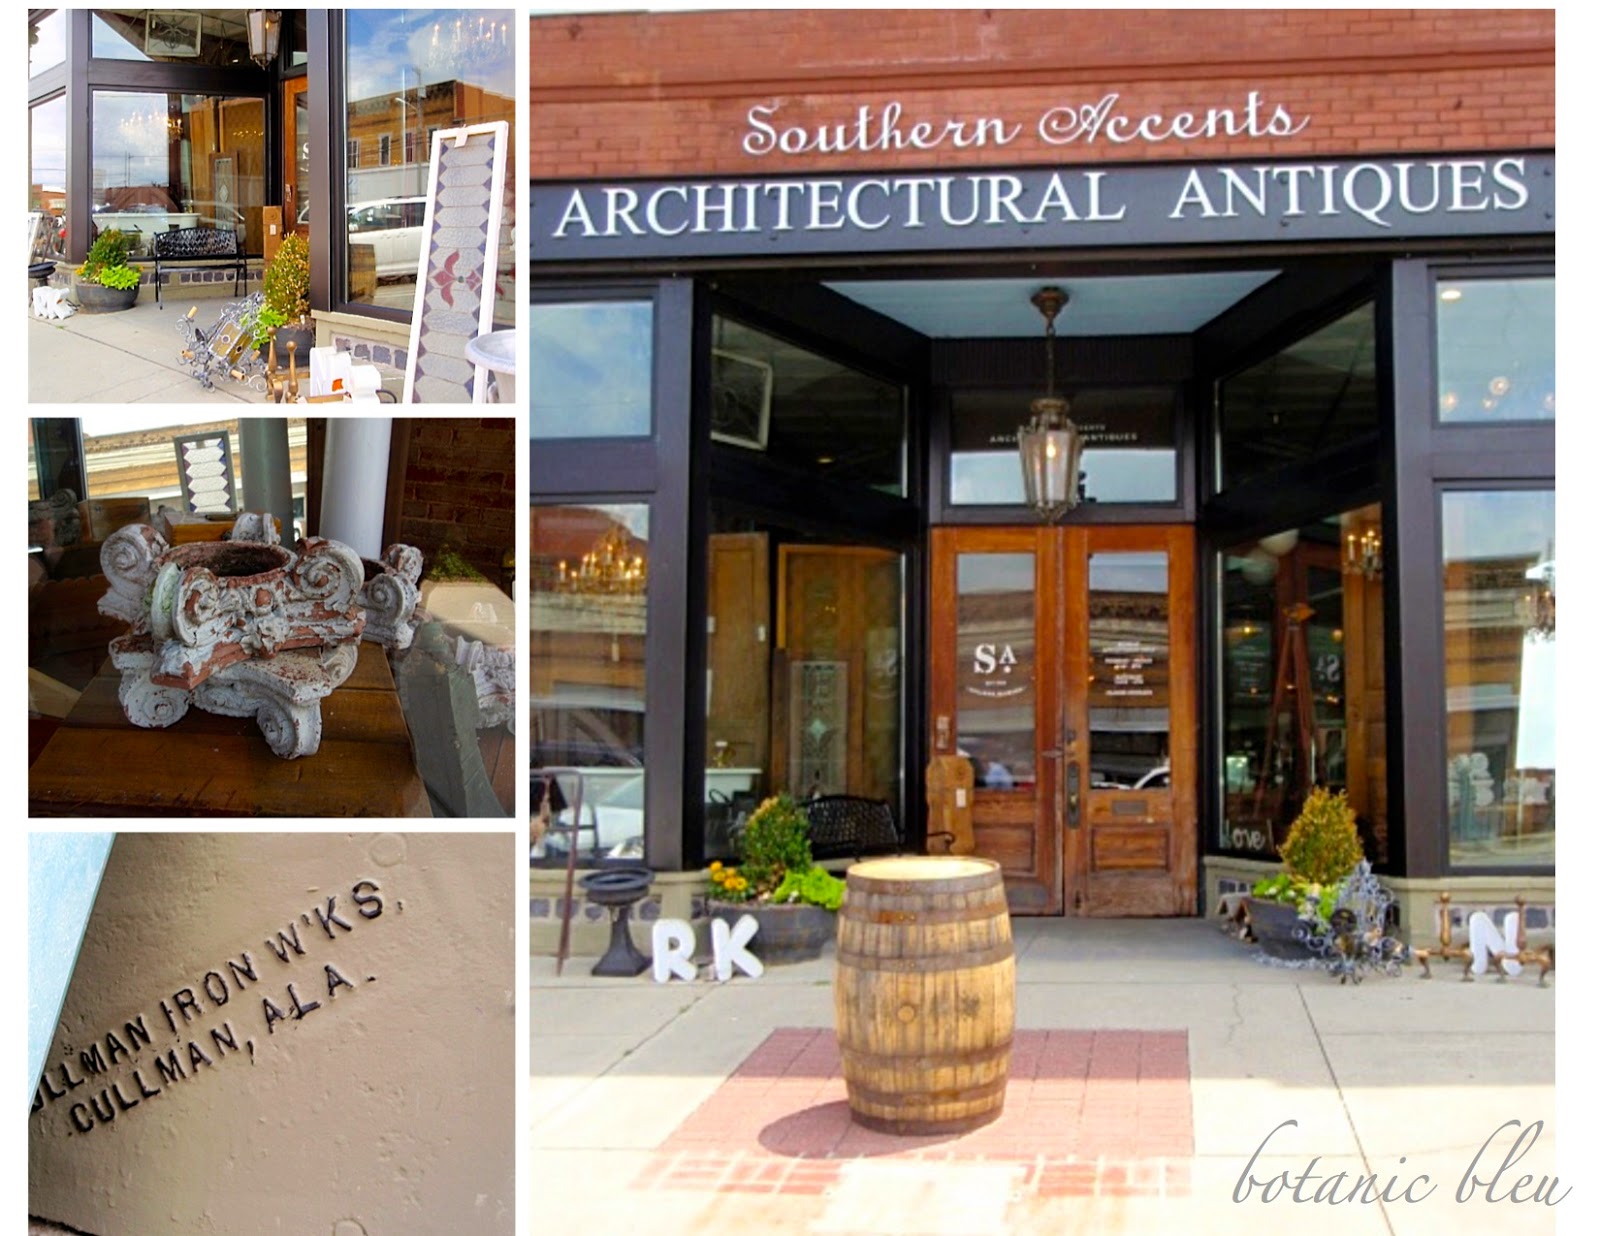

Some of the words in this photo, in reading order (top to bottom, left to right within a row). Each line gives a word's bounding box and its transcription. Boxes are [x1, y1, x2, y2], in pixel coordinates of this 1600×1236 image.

[742, 101, 1023, 156] Southern
[1038, 90, 1310, 145] Accents
[552, 171, 1126, 239] ARCHITECTURAL
[1168, 157, 1529, 228] ANTIQUES
[1469, 911, 1523, 977] N
[31, 1014, 152, 1113] ULLMAN
[160, 951, 258, 1034] IRON
[69, 1023, 255, 1133] CULLMAN,
[262, 963, 377, 1034] ALA.
